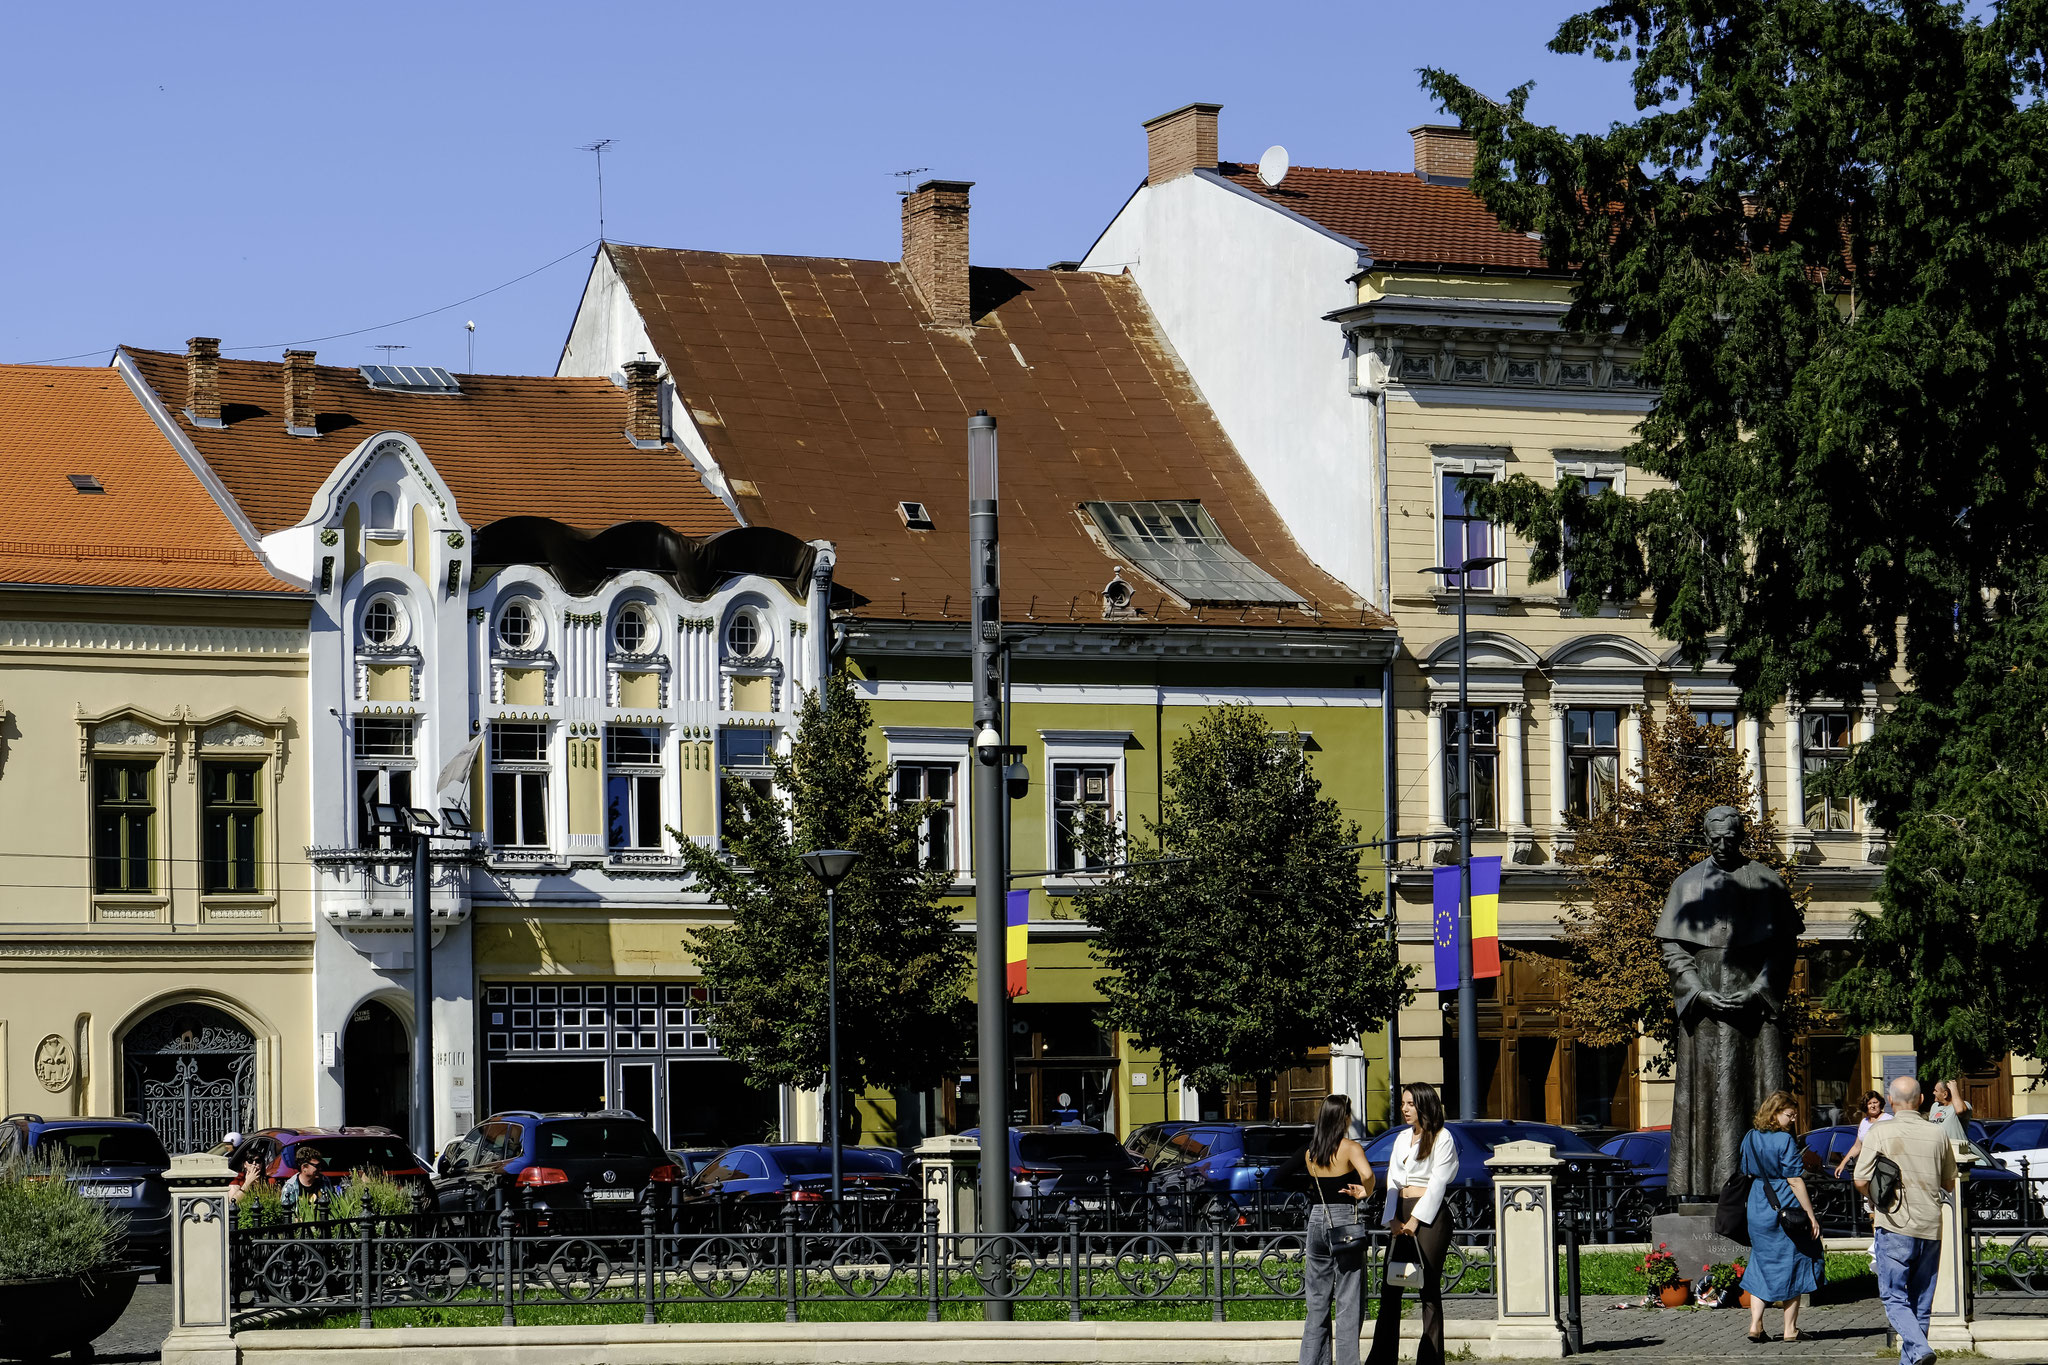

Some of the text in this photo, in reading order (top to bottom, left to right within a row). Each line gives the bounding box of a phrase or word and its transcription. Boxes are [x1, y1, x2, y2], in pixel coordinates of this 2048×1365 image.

[113, 1186, 129, 1194] JRS
[617, 1190, 630, 1198] VIP
[1708, 1245, 1752, 1253] 1896-1980
